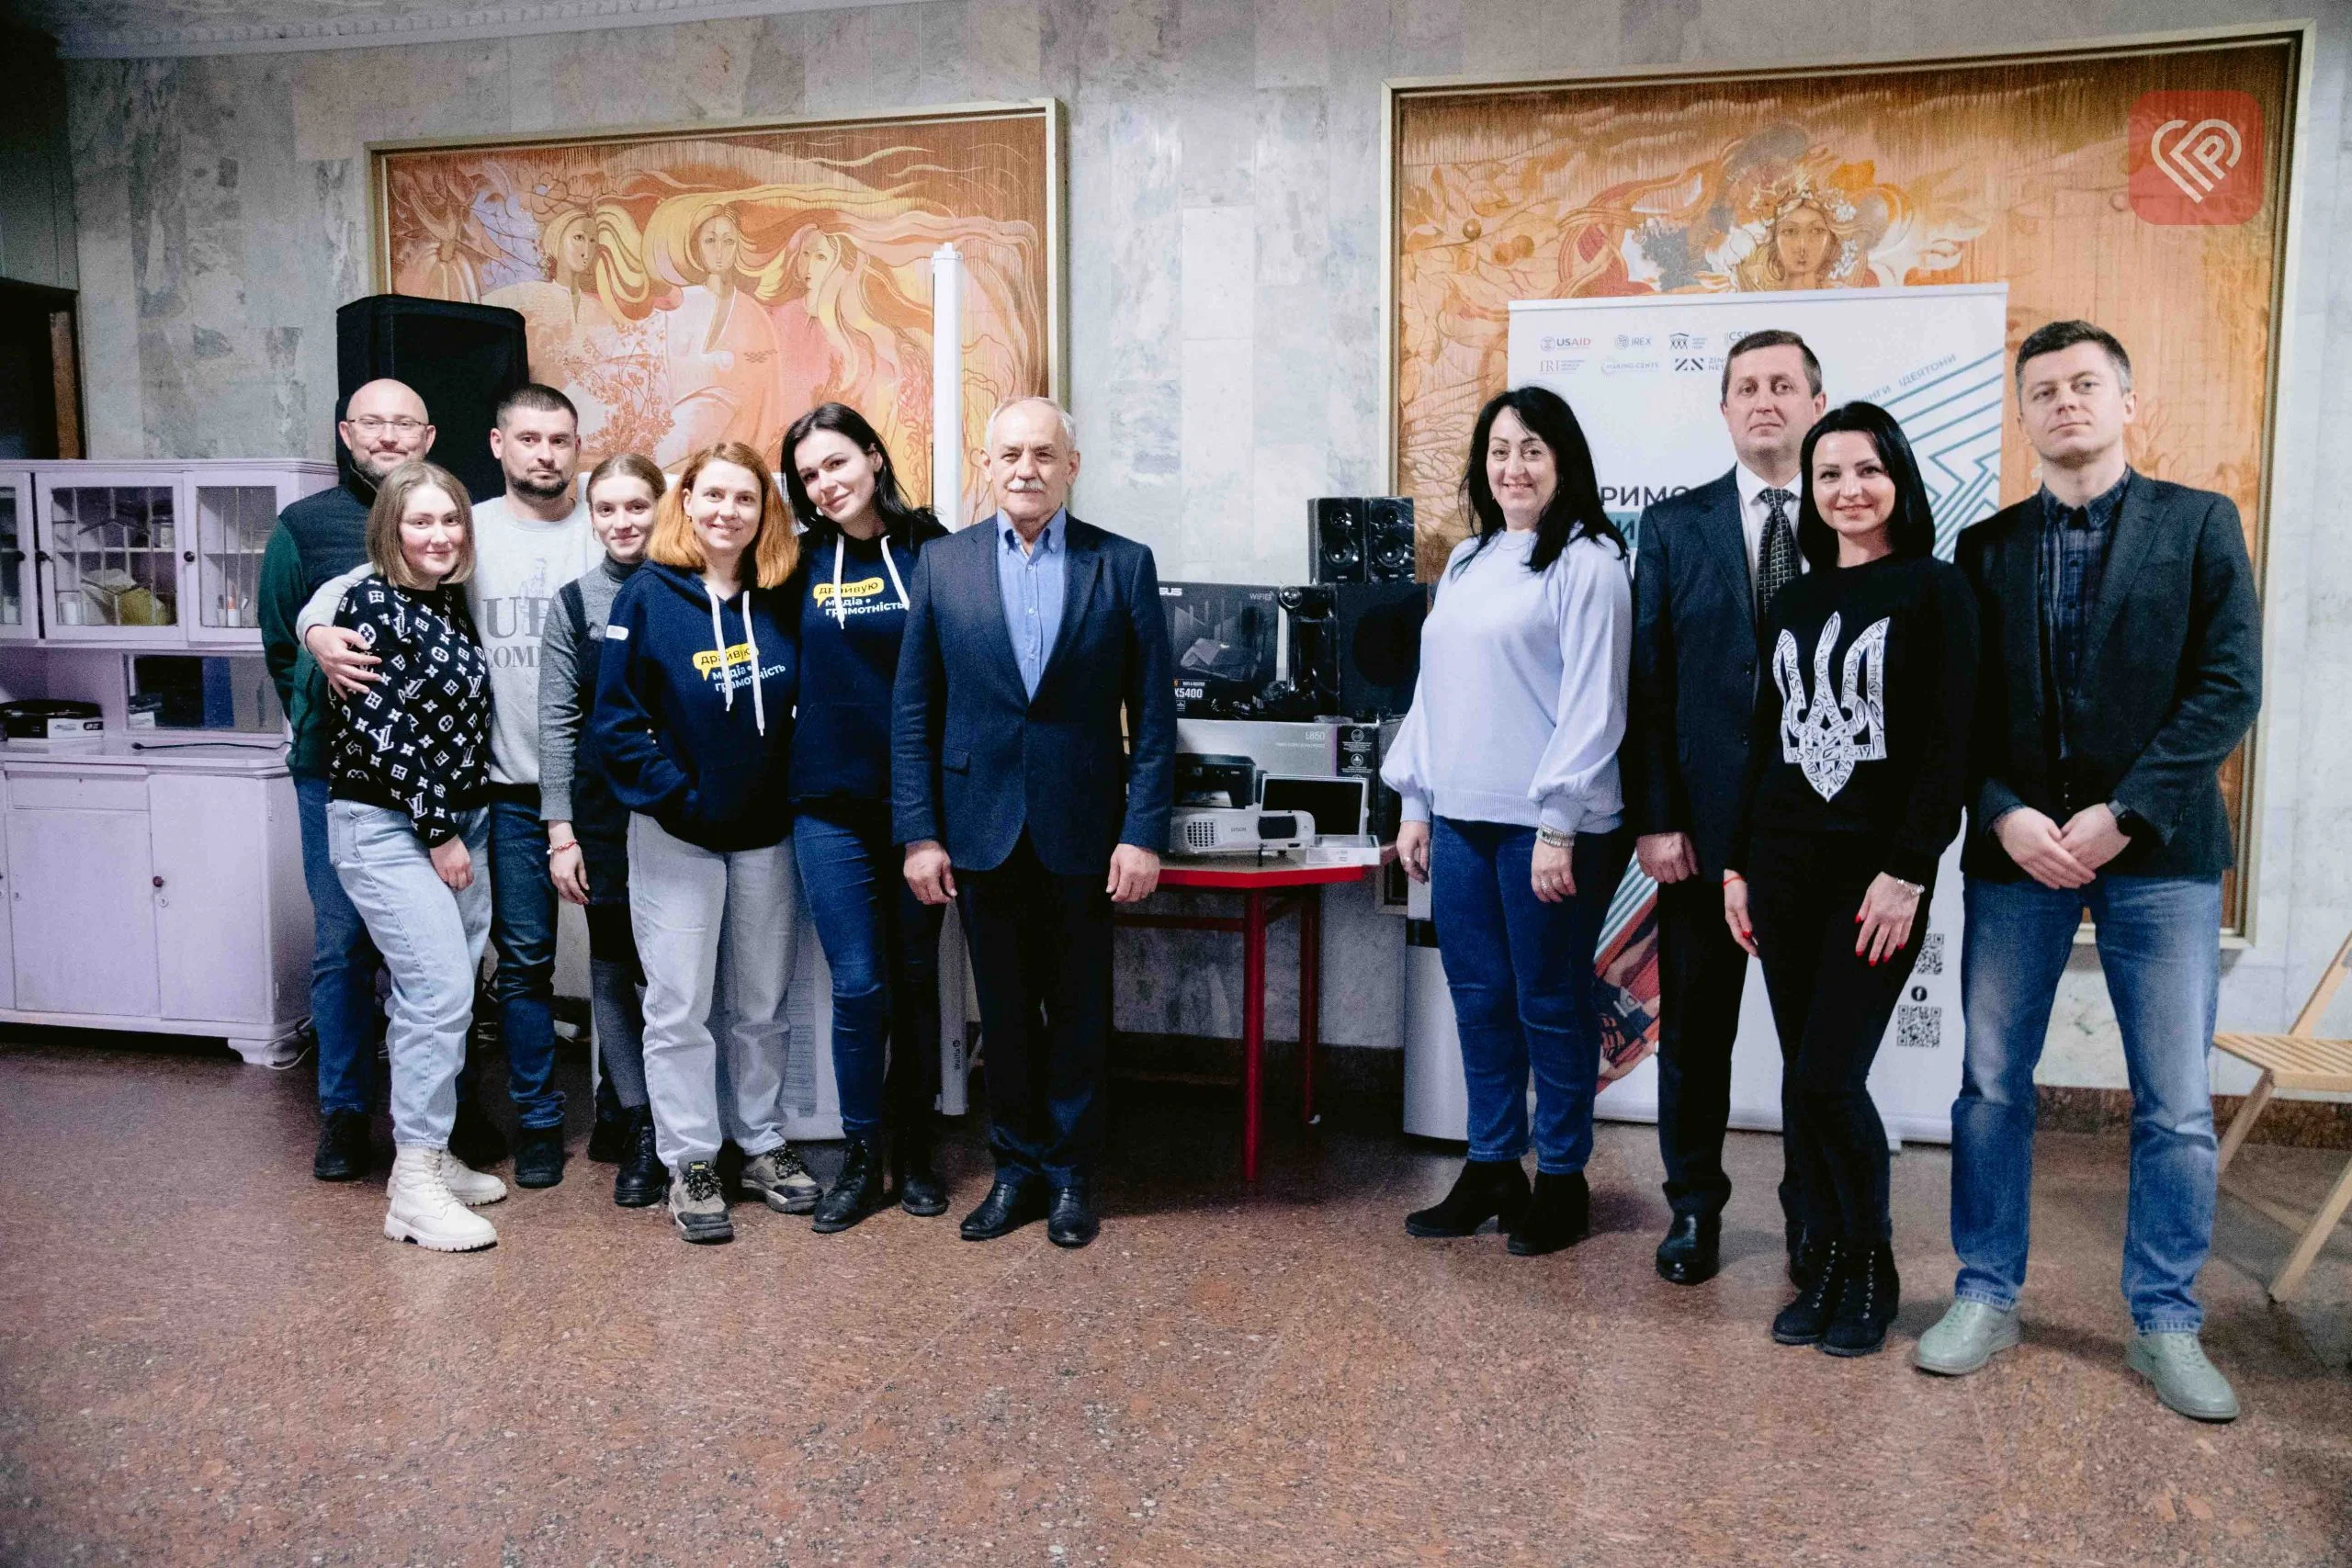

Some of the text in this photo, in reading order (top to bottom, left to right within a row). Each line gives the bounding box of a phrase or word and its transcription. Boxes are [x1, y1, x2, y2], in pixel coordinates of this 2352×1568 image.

[1556, 337, 1591, 347] USAID
[1631, 337, 1652, 346] IREX
[1540, 359, 1559, 372] IRI
[1898, 354, 1956, 387] ІДЕЯТОНИ
[1600, 485, 1689, 506] РИМ
[819, 581, 878, 595] дрйвую
[1159, 587, 1183, 597] SUS
